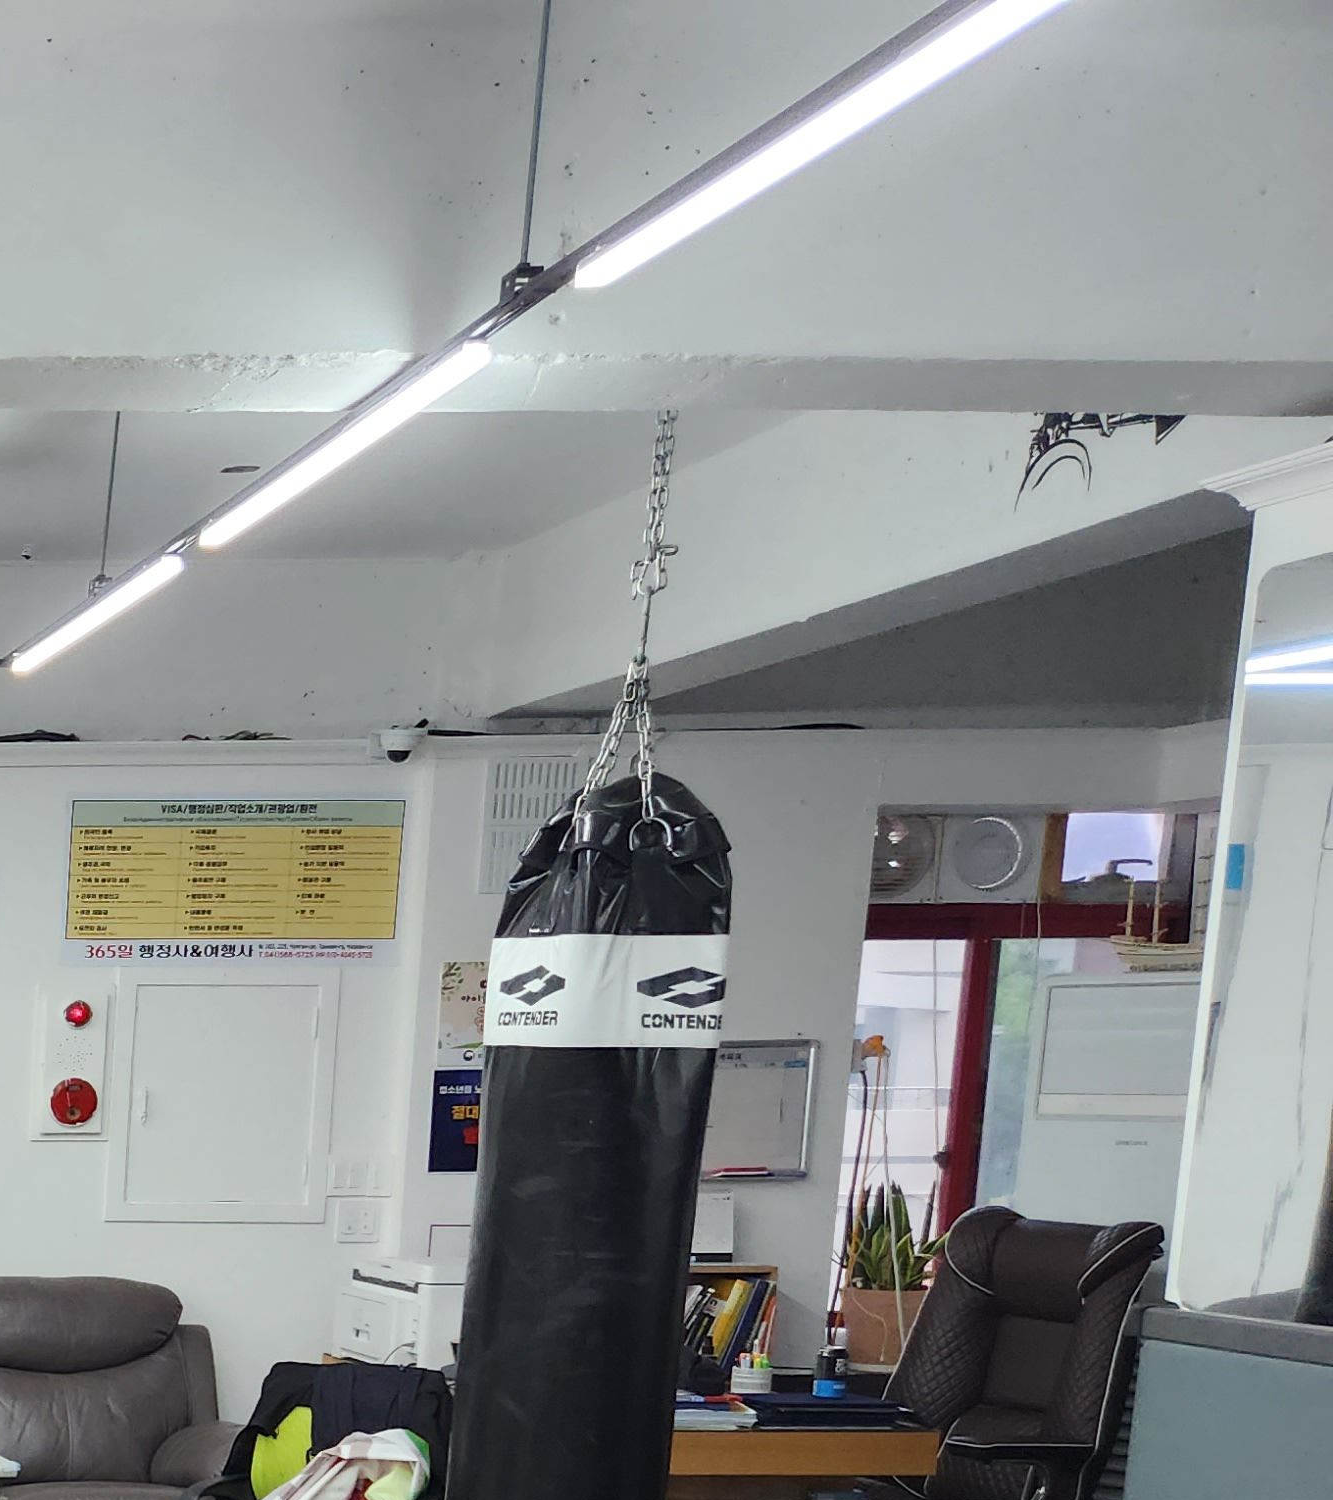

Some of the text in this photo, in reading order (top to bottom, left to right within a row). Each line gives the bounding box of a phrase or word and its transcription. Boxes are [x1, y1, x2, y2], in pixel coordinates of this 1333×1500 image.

[84, 944, 133, 959] 365일
[139, 943, 254, 959] 행정사&여행사
[497, 1010, 559, 1026] CONTENDER
[641, 1013, 724, 1030] CONTENDE
